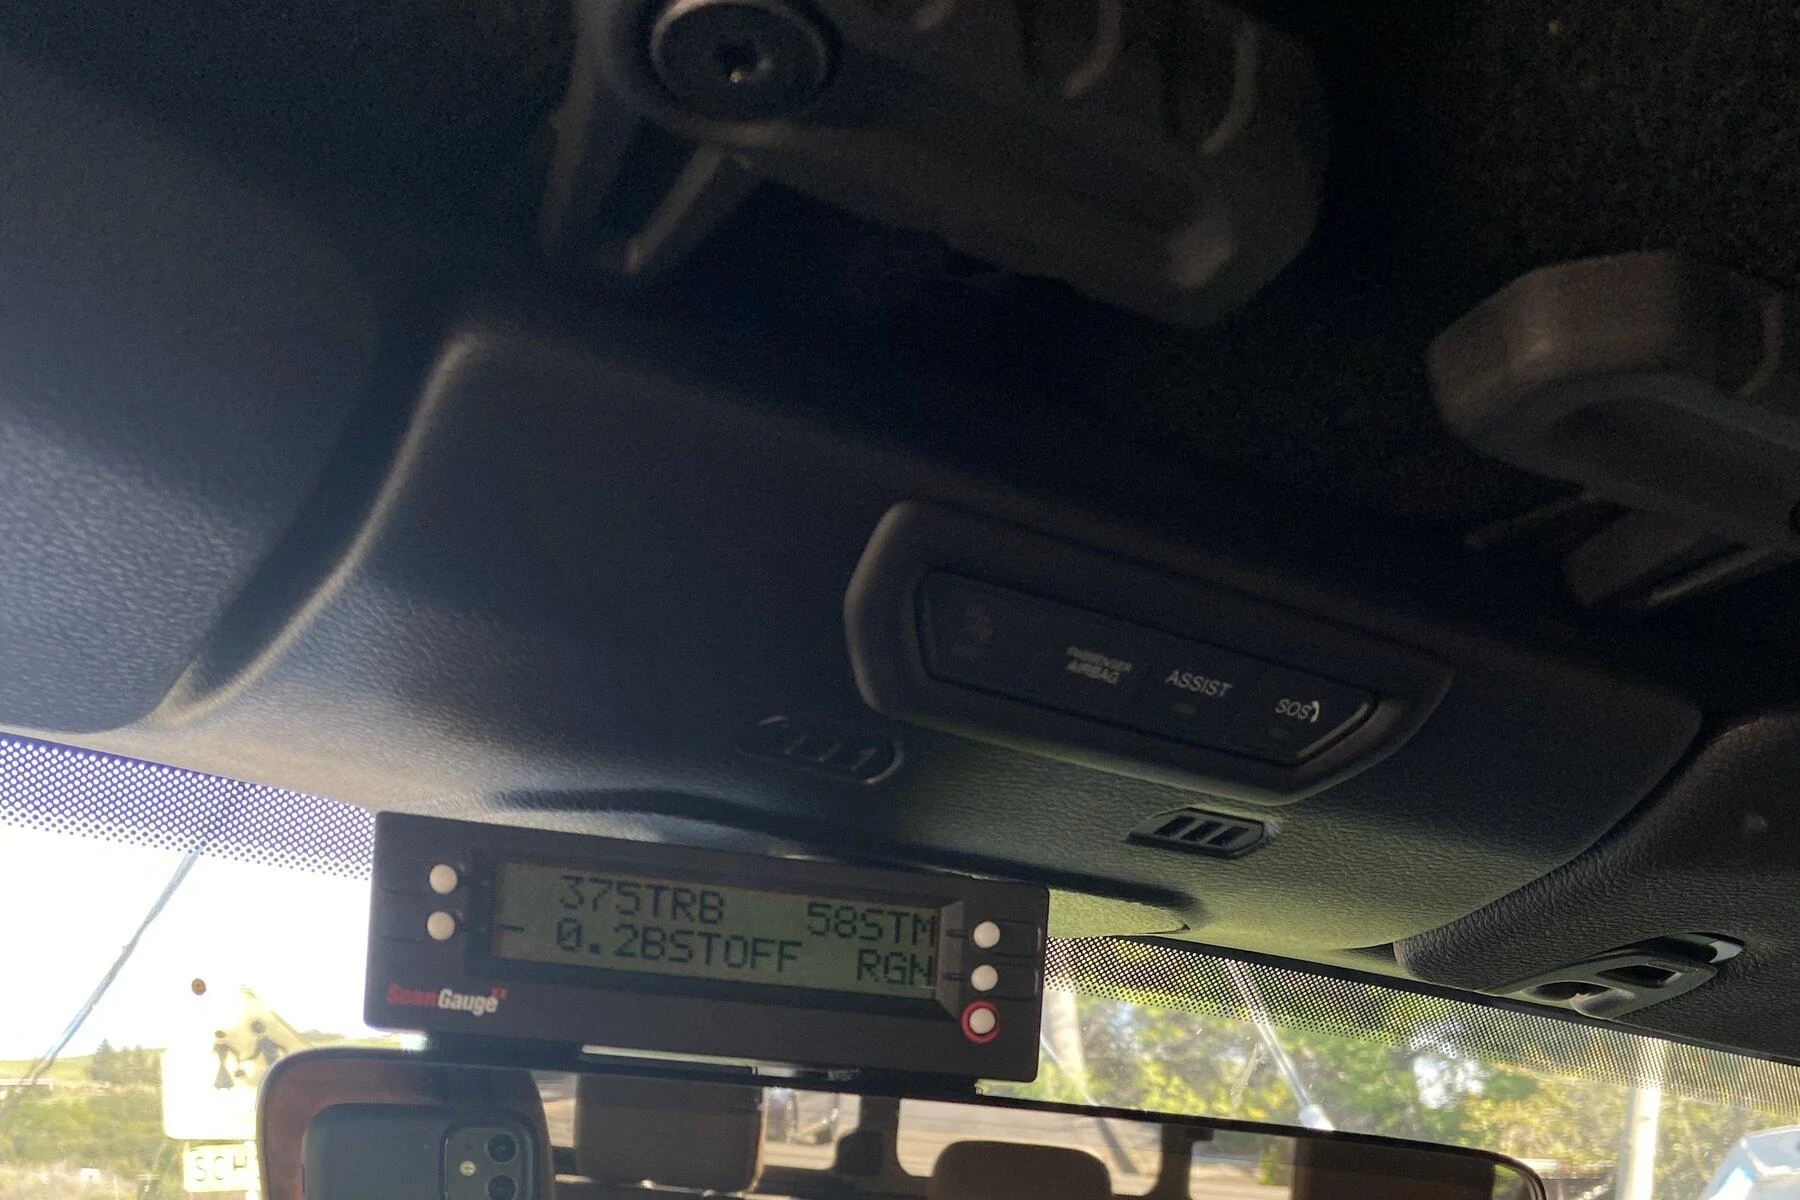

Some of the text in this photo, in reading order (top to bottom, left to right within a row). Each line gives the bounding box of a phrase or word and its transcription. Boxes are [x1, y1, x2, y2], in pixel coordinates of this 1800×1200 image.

[1164, 668, 1234, 698] ASSIST
[1275, 698, 1314, 720] SOS
[558, 874, 937, 947] 375TRB 58STM
[856, 949, 936, 986] RGN
[193, 1155, 250, 1182] SCH
